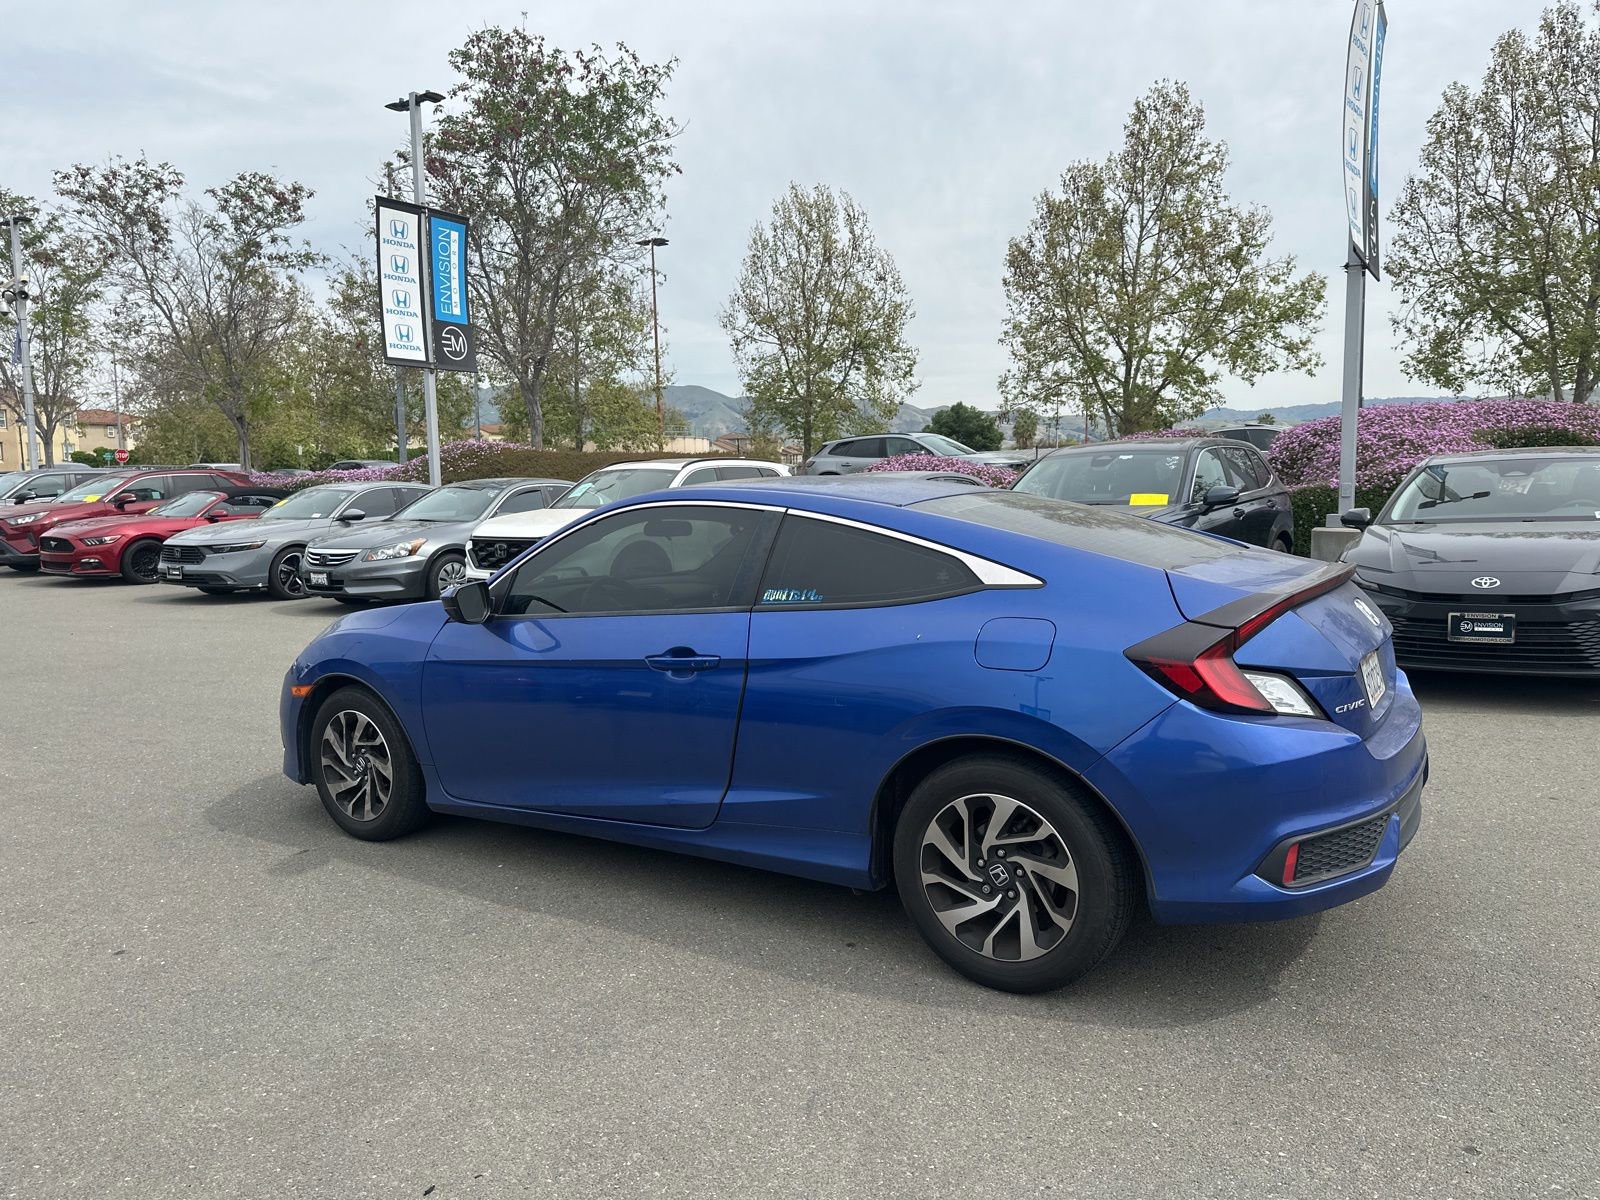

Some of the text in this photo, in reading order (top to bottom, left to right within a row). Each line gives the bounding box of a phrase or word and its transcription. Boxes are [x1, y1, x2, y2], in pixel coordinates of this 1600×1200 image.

[382, 238, 415, 249] HONDA
[437, 227, 451, 314] ENVISION
[383, 273, 416, 284] HONDA
[385, 307, 419, 319] HONDA
[388, 341, 422, 352] HONDA
[1335, 698, 1365, 714] CIVIC
